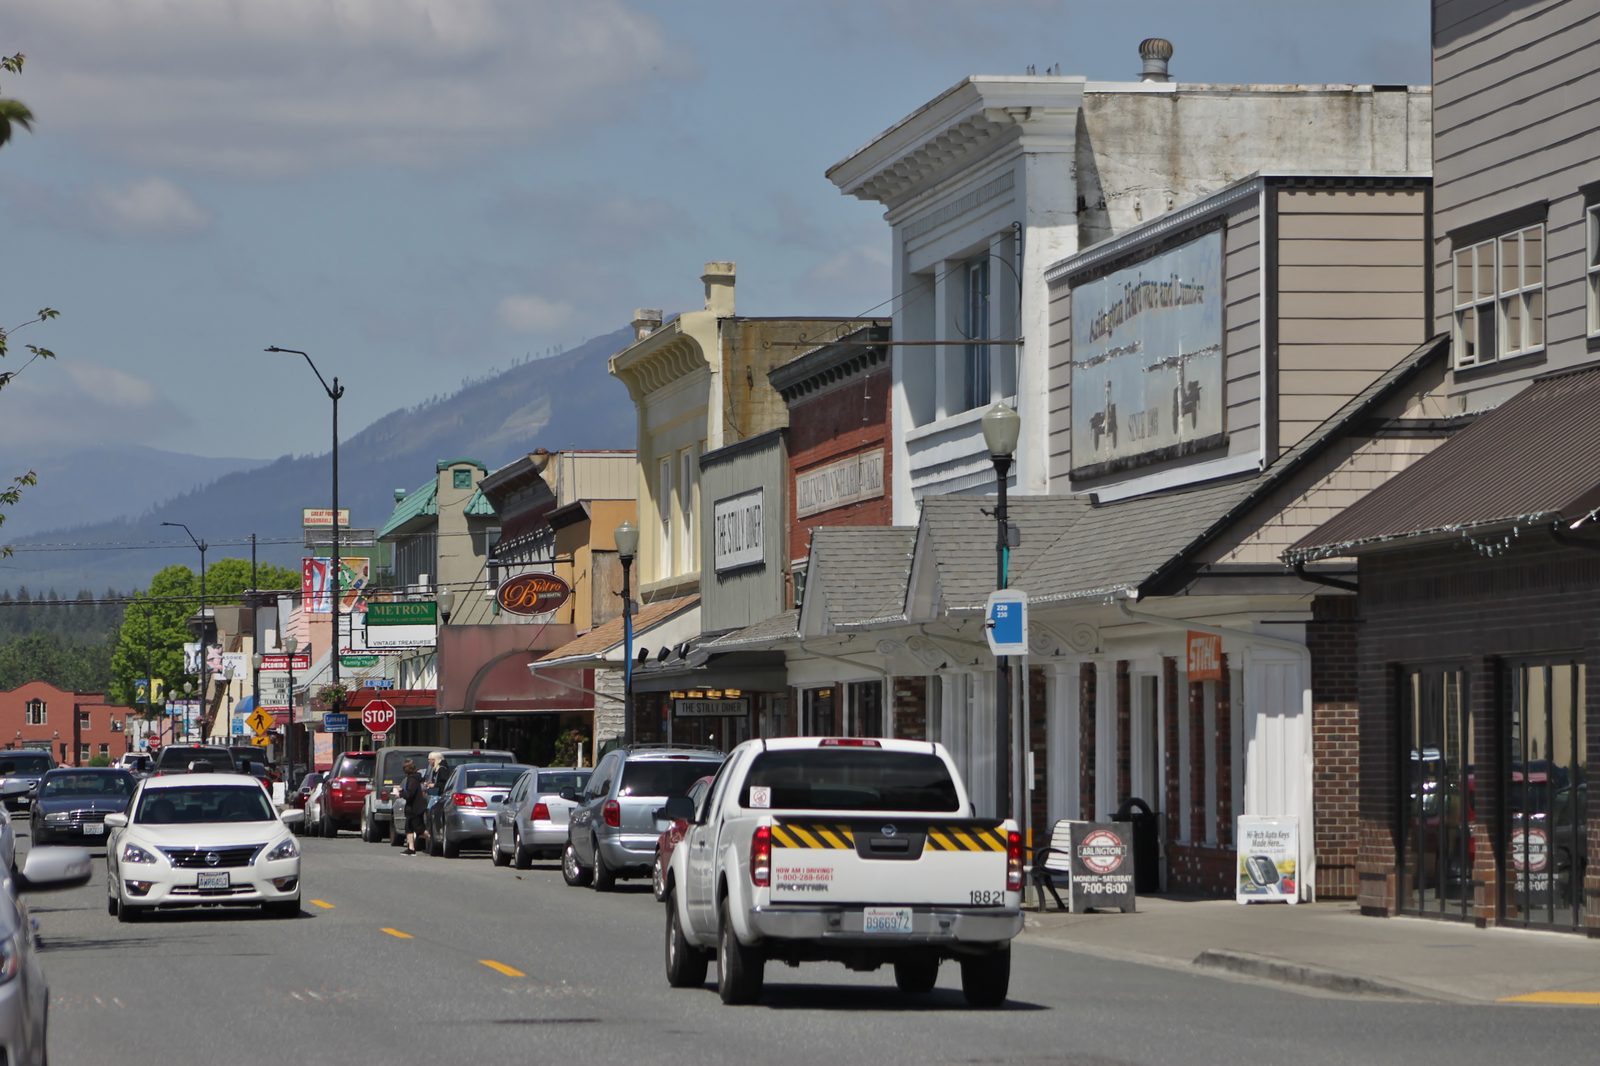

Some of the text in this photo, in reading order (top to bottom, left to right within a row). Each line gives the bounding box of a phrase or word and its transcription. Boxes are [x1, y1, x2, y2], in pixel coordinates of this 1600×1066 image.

[716, 514, 726, 557] THE
[504, 579, 562, 608] Bistro
[375, 604, 429, 615] METRON
[1190, 636, 1220, 672] STIHL
[682, 702, 742, 713] THE STILLY DINER
[364, 710, 393, 723] STOP
[970, 890, 1005, 904] 18821
